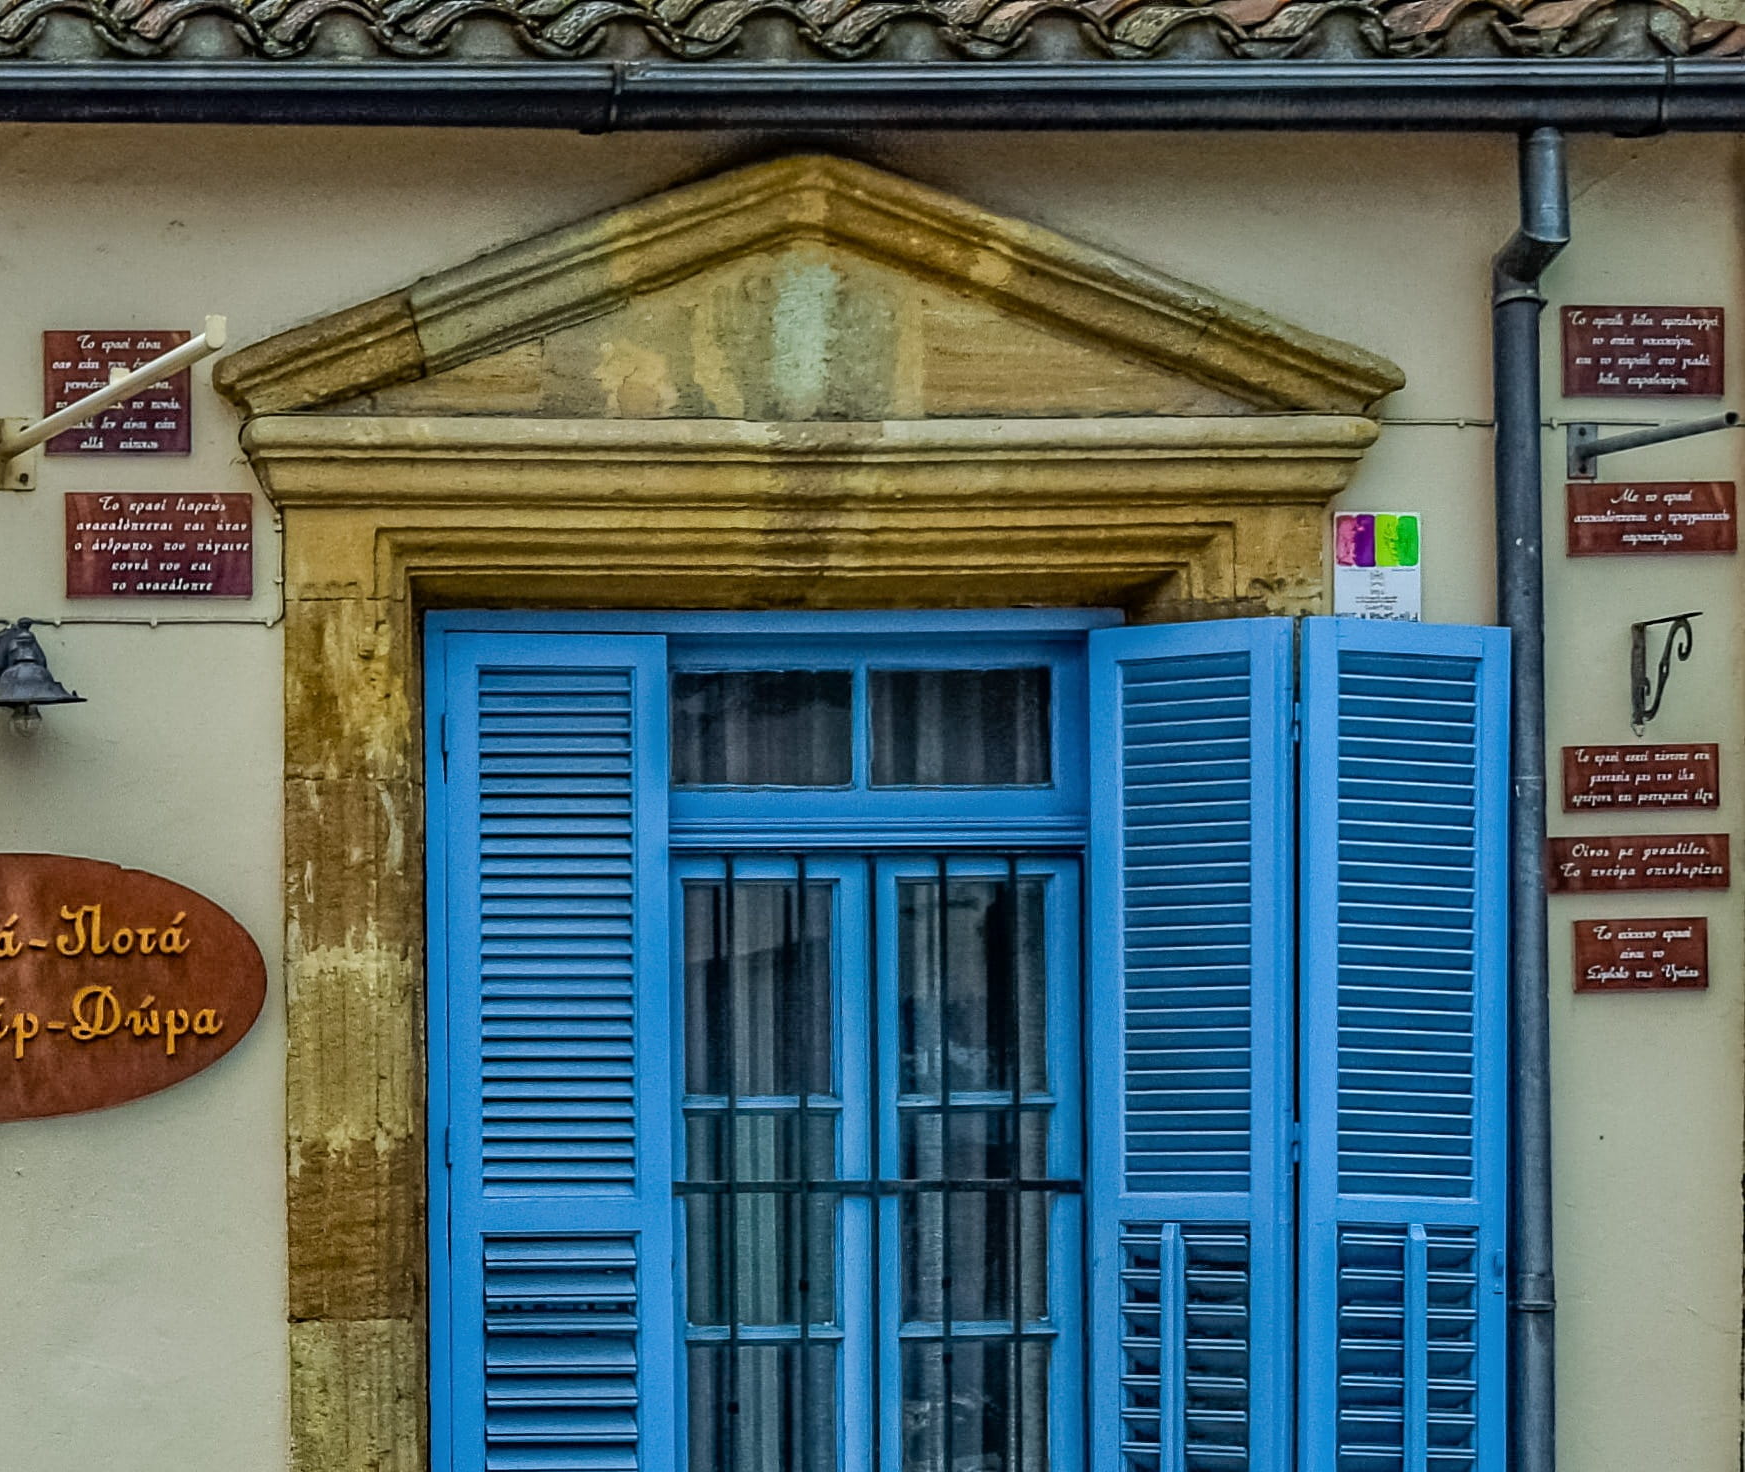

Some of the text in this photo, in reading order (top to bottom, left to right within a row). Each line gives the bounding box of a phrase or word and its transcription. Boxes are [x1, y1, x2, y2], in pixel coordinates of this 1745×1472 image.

[97, 493, 226, 516] Το κρασί διαρκώς
[75, 516, 247, 531] ανακαλύπτεται και ήταν
[73, 536, 250, 556] ο άνθρωπος που πήγαινε
[110, 557, 212, 571] κοντά του και
[111, 576, 213, 591] το ανακάλυπτε
